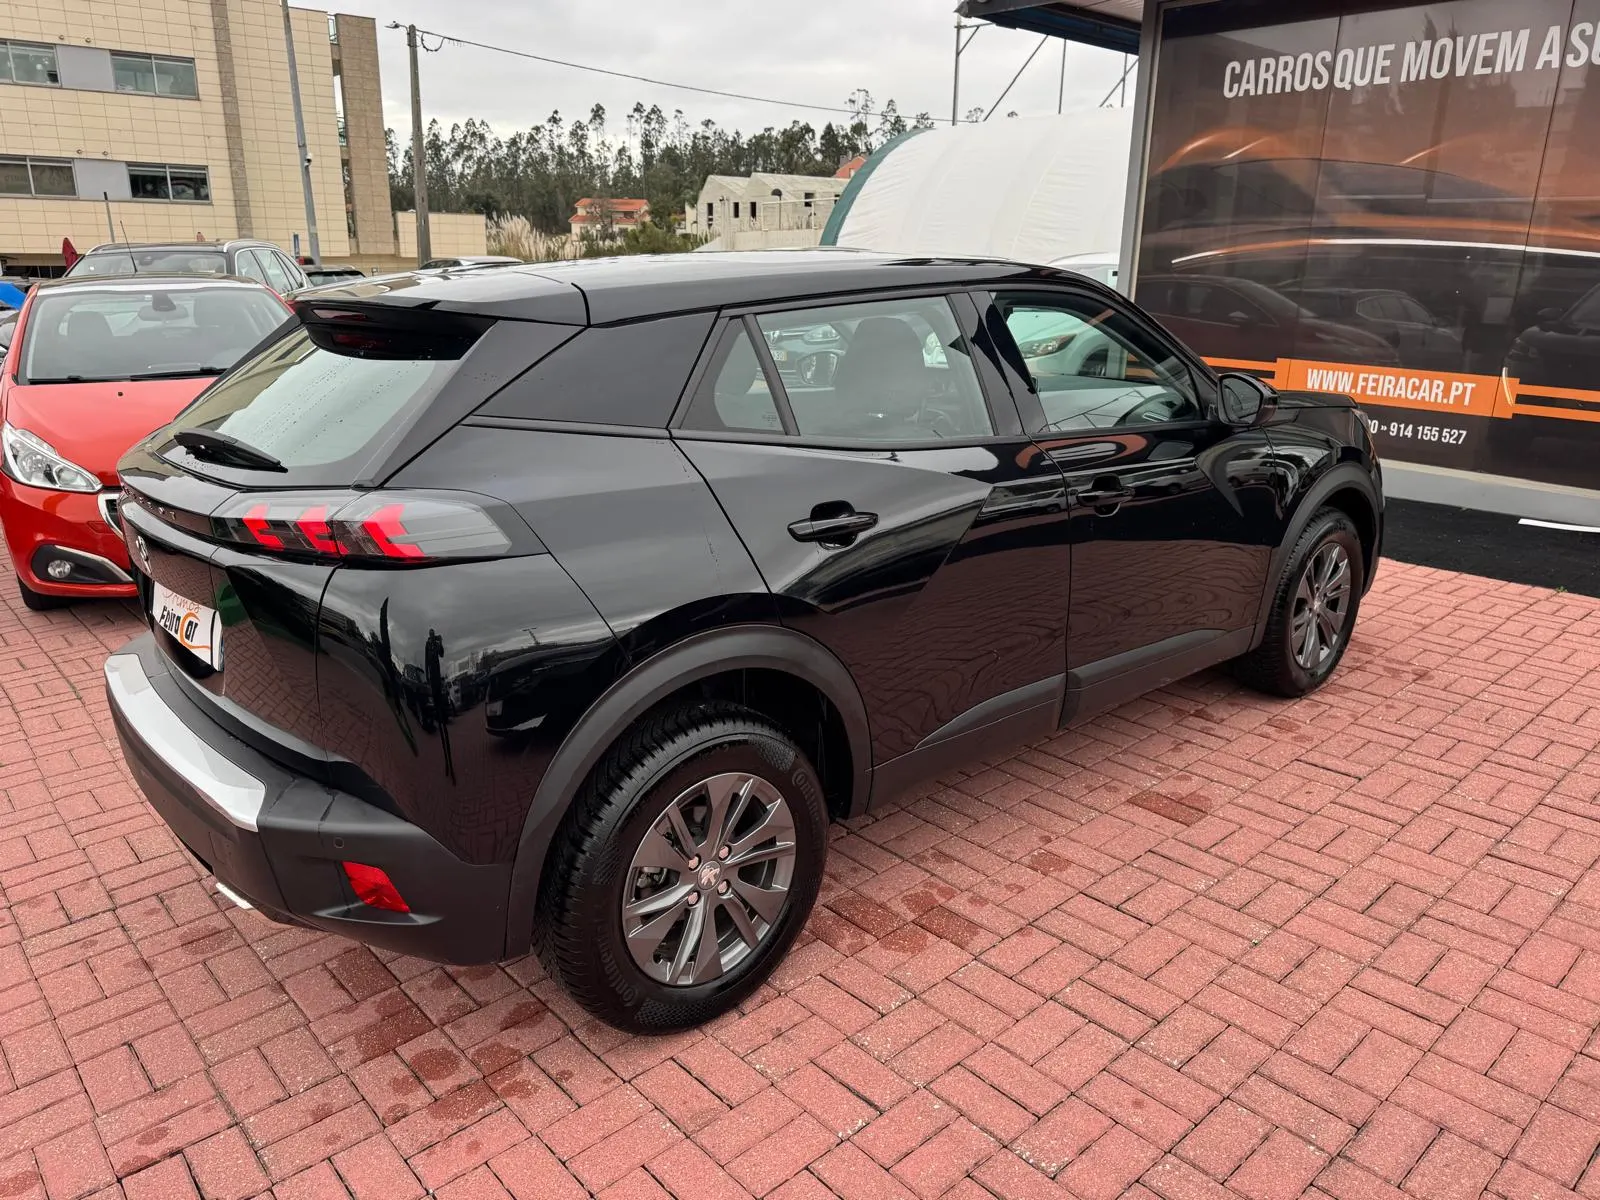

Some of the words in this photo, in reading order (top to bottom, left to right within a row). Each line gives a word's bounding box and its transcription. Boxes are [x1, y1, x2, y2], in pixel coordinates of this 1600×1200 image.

[1223, 51, 1332, 99] CARROS
[1333, 44, 1396, 91] QUE
[1400, 28, 1531, 83] MOVEM
[1534, 25, 1561, 70] A
[1306, 368, 1477, 406] WWW.FEIRACAR.PT
[1389, 421, 1413, 439] 914
[1417, 425, 1439, 442] 155
[1441, 428, 1467, 445] 527
